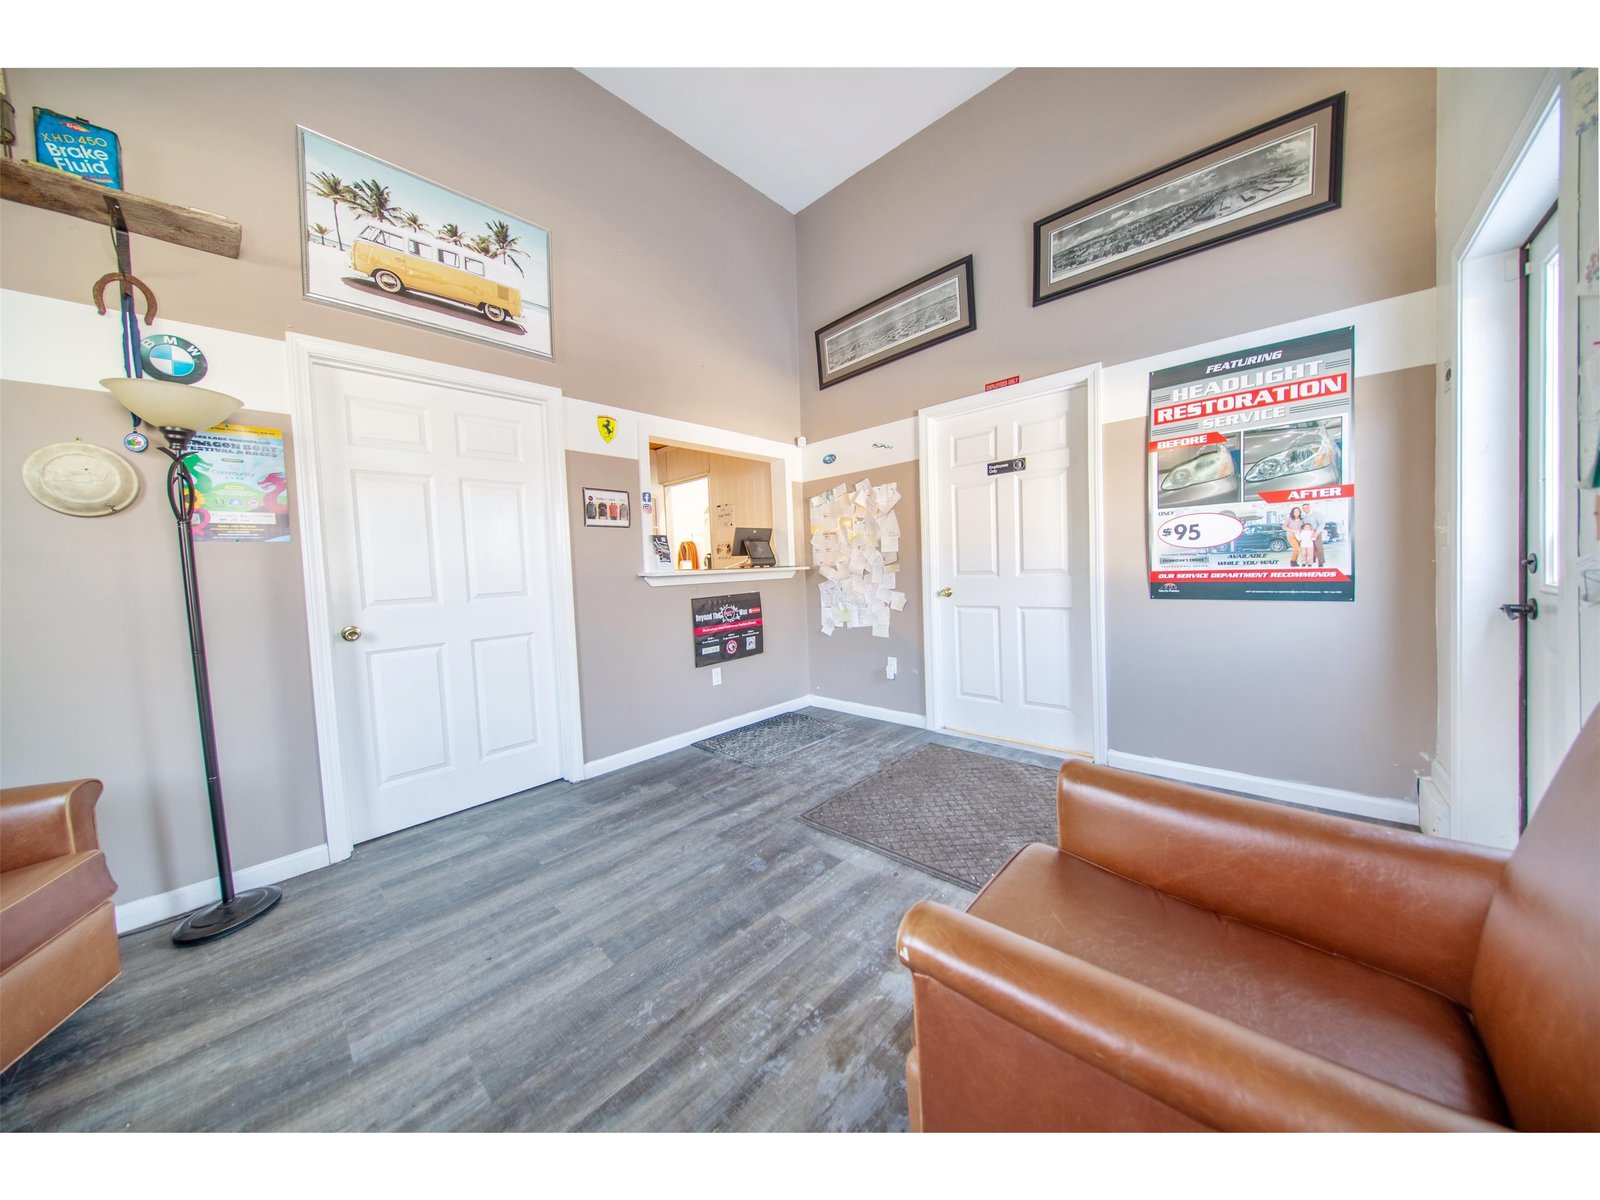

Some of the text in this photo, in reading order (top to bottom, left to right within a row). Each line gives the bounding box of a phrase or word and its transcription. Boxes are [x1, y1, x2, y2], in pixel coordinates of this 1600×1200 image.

[78, 135, 108, 147] 450
[45, 142, 109, 161] Brake
[53, 157, 110, 175] Fluid
[141, 335, 201, 356] BMW
[1205, 350, 1283, 374] FEATURING
[986, 377, 1018, 391] EMPLOYEES ONLY
[1172, 360, 1324, 402] HEADLIGHT
[1157, 376, 1342, 422] RESTORATION
[1202, 406, 1287, 430] SERVICE
[186, 445, 235, 454] ESTIVAL
[243, 444, 279, 452] BOAT
[1157, 434, 1208, 450] BEFORE
[211, 469, 256, 479] Community
[1287, 487, 1342, 500] AFTER
